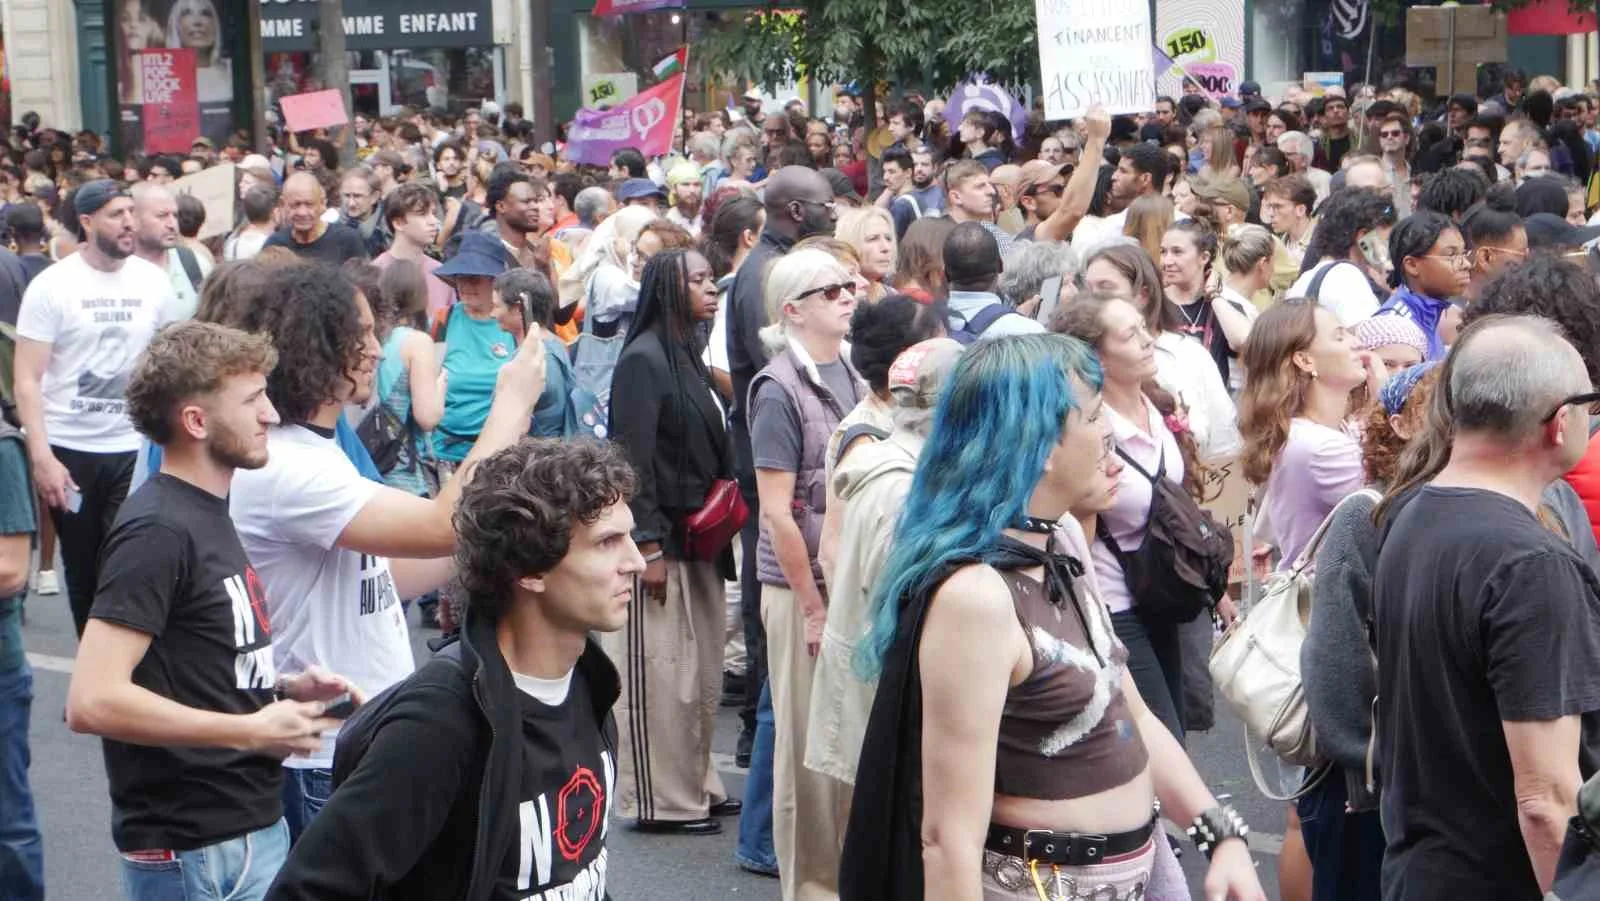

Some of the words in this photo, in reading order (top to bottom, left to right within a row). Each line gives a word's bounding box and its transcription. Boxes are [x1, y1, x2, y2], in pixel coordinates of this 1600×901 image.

[260, 19, 303, 37] MME
[342, 16, 385, 35] MME
[400, 13, 478, 33] ENFANT
